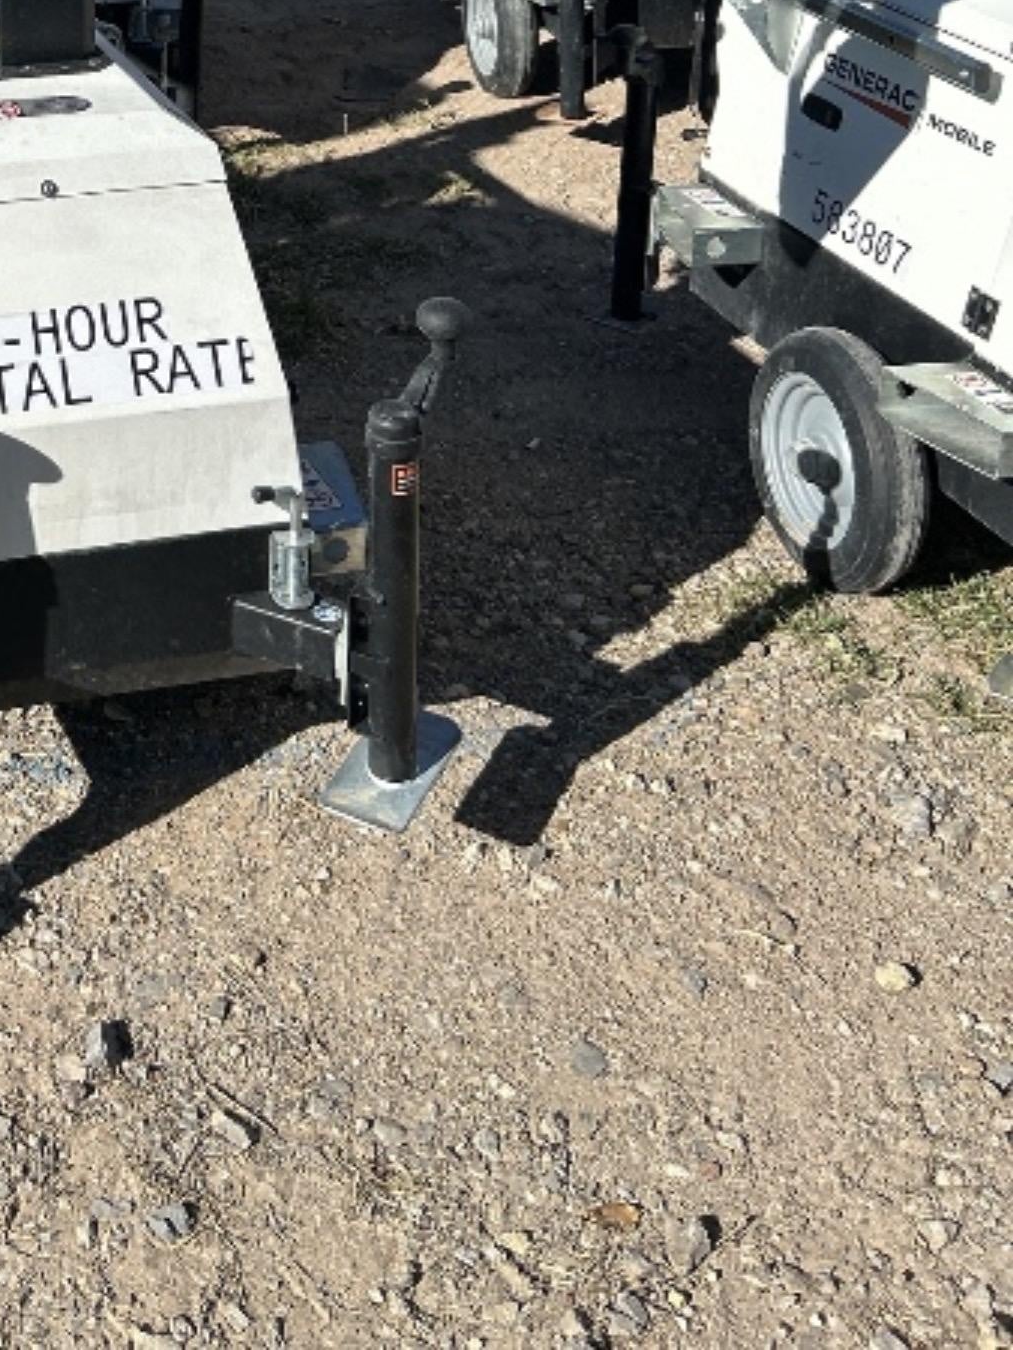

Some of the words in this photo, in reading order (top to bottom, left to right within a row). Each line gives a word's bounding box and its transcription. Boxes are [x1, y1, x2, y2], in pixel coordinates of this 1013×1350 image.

[824, 53, 921, 113] GENERAC
[926, 113, 996, 157] MOBILE
[811, 188, 912, 274] 583807
[128, 336, 255, 398] RATE
